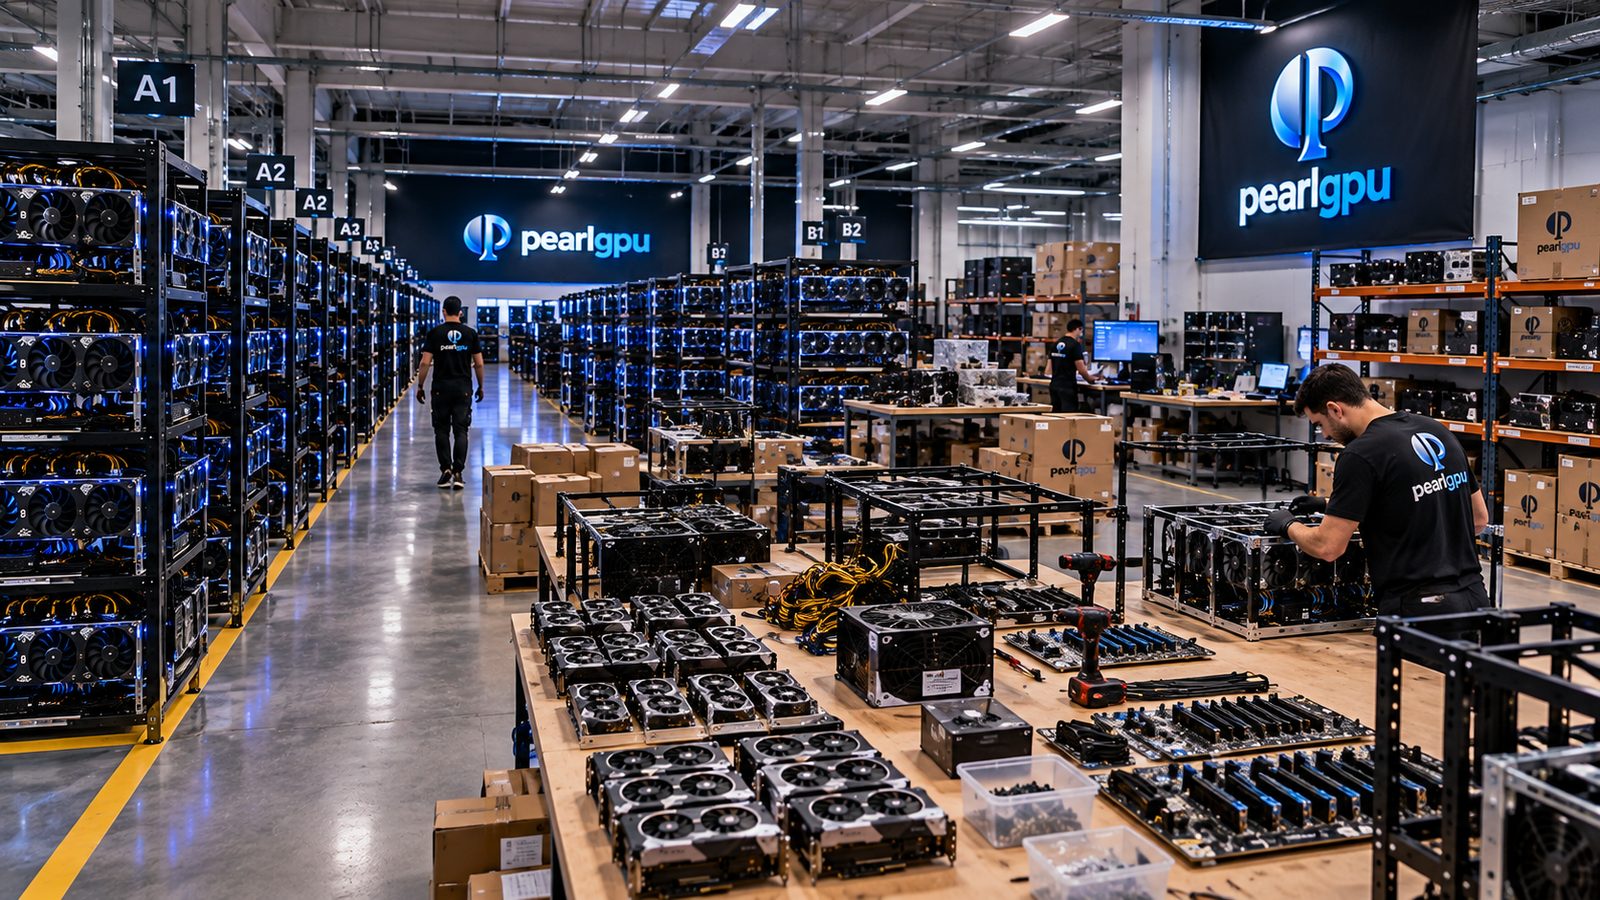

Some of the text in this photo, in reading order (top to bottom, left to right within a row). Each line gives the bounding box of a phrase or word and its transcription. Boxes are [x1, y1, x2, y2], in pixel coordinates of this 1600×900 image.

[133, 74, 177, 103] A1
[255, 162, 286, 182] A2
[303, 194, 327, 211] A2
[1239, 166, 1391, 227] pearlgpu
[807, 226, 824, 240] B1
[842, 222, 862, 237] B2
[521, 225, 651, 259] pearlgpu
[1537, 241, 1580, 255] pearlgpu
[1411, 471, 1468, 502] pearlgpu
